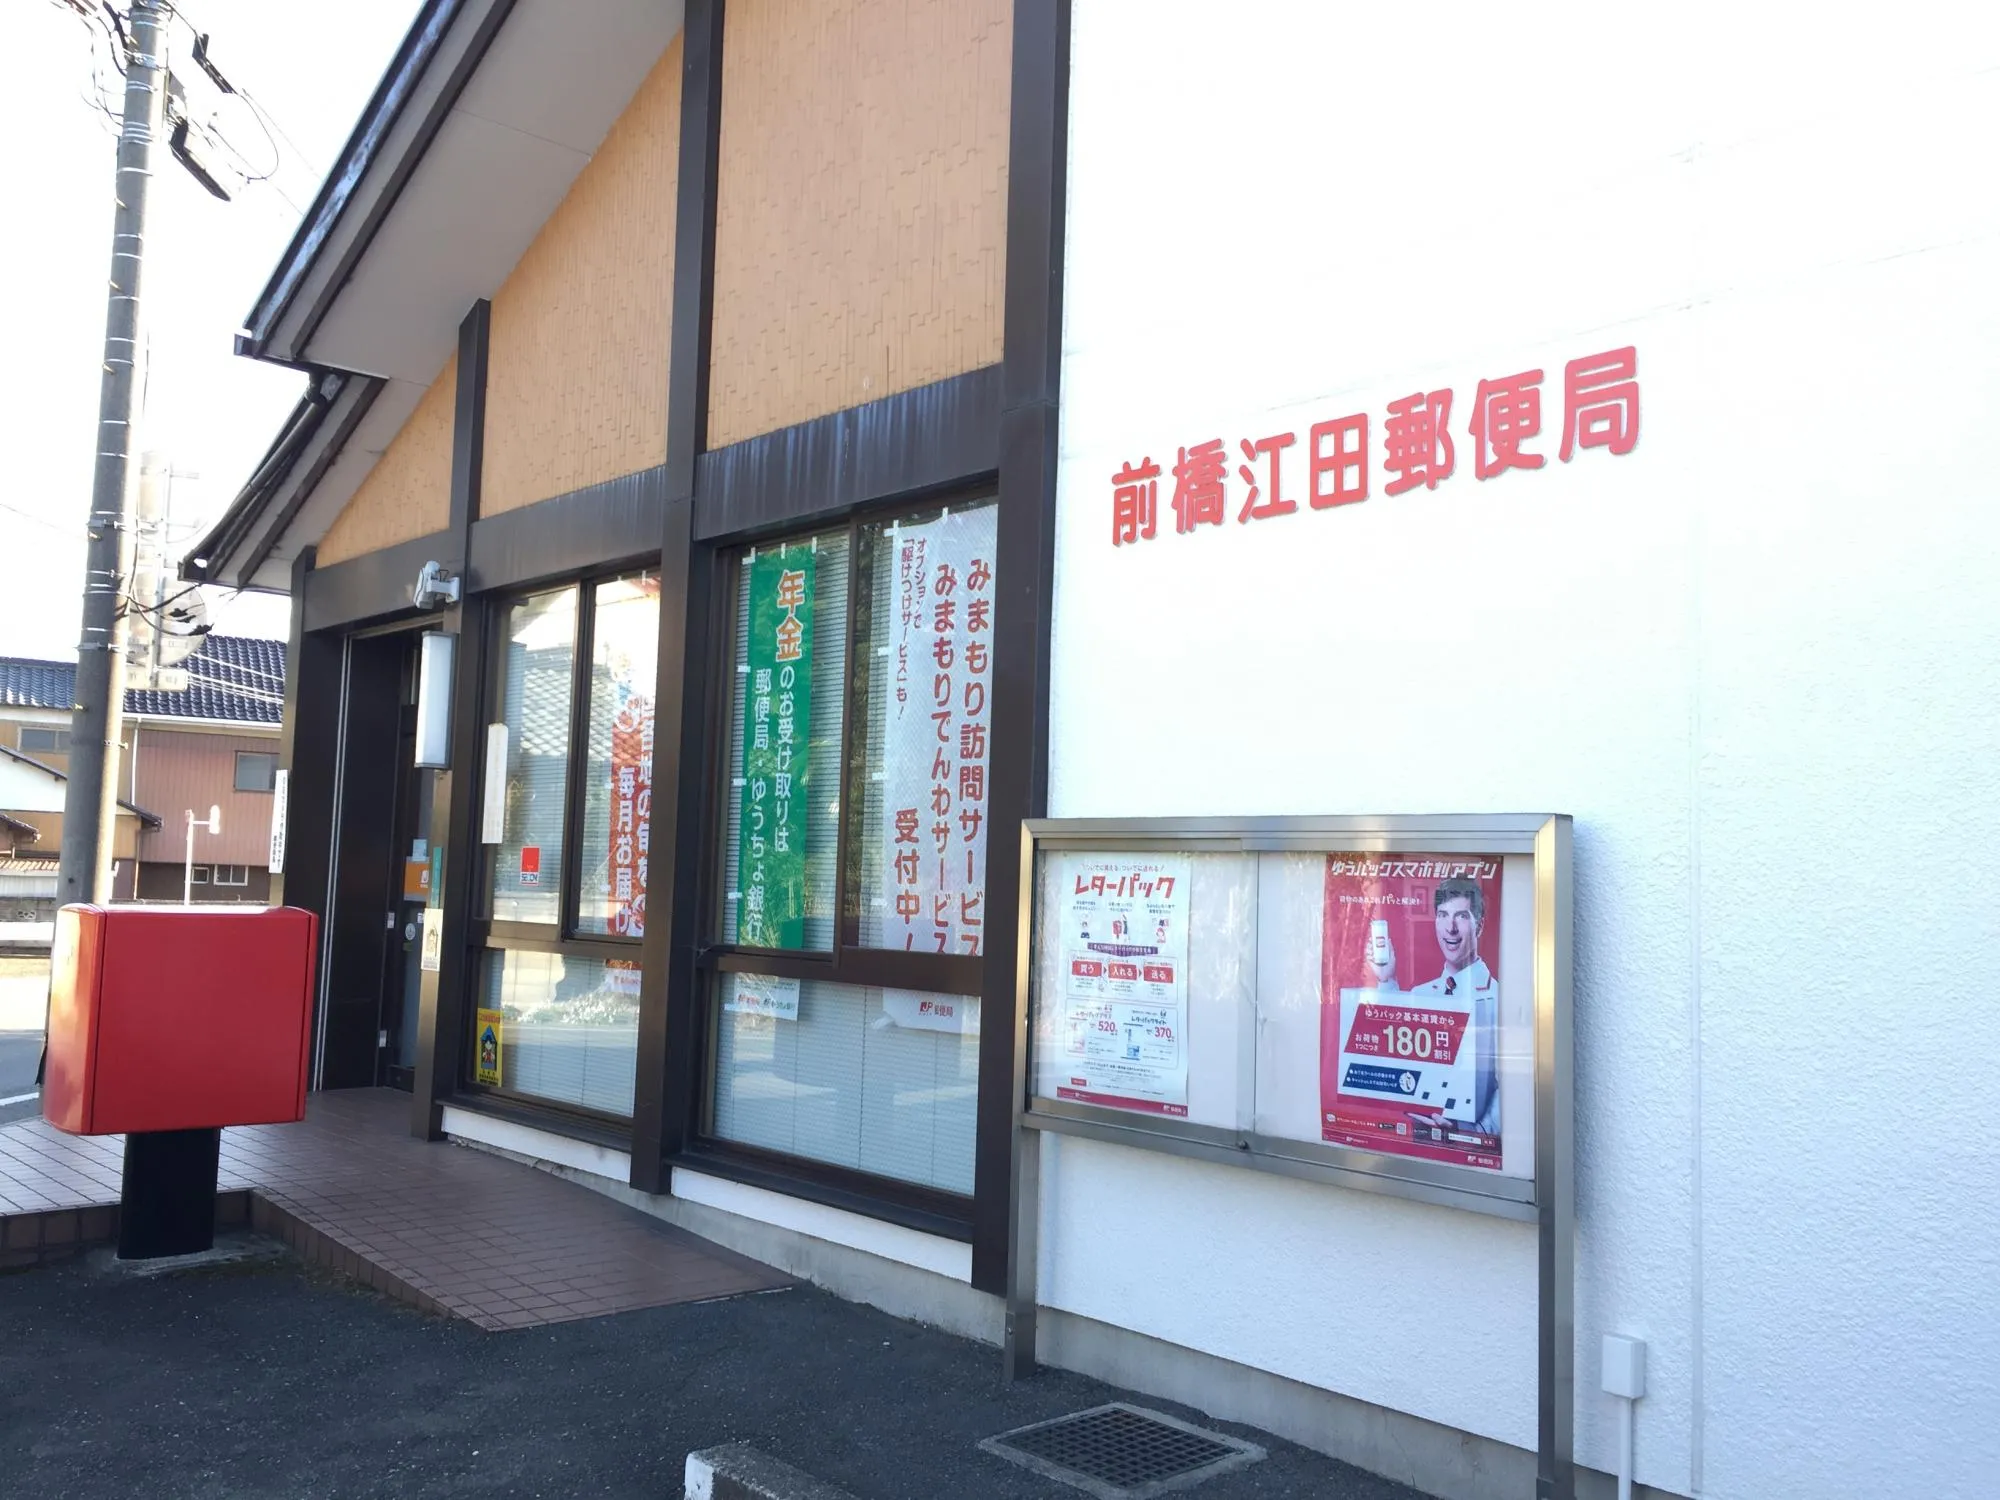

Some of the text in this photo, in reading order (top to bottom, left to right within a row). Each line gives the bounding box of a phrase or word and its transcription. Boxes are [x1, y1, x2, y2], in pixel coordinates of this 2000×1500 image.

[1112, 346, 1640, 547] 前橋江田郵便局
[775, 569, 805, 852] 年金のお受け取りは
[931, 564, 958, 953] みまもりでんわサービス
[959, 558, 992, 955] みまもり訪問サービス
[747, 668, 772, 940] 郵便局・ゆうちょ銀行
[1332, 860, 1497, 879] ゆうパックスマホ割アプリ
[1075, 873, 1175, 898] レターパック
[1080, 964, 1095, 974] 買う
[1112, 966, 1134, 977] 入れる
[1098, 1020, 1116, 1032] 520
[1365, 1006, 1454, 1026] ゆうパック基本運賃から
[1154, 1026, 1172, 1039] 370
